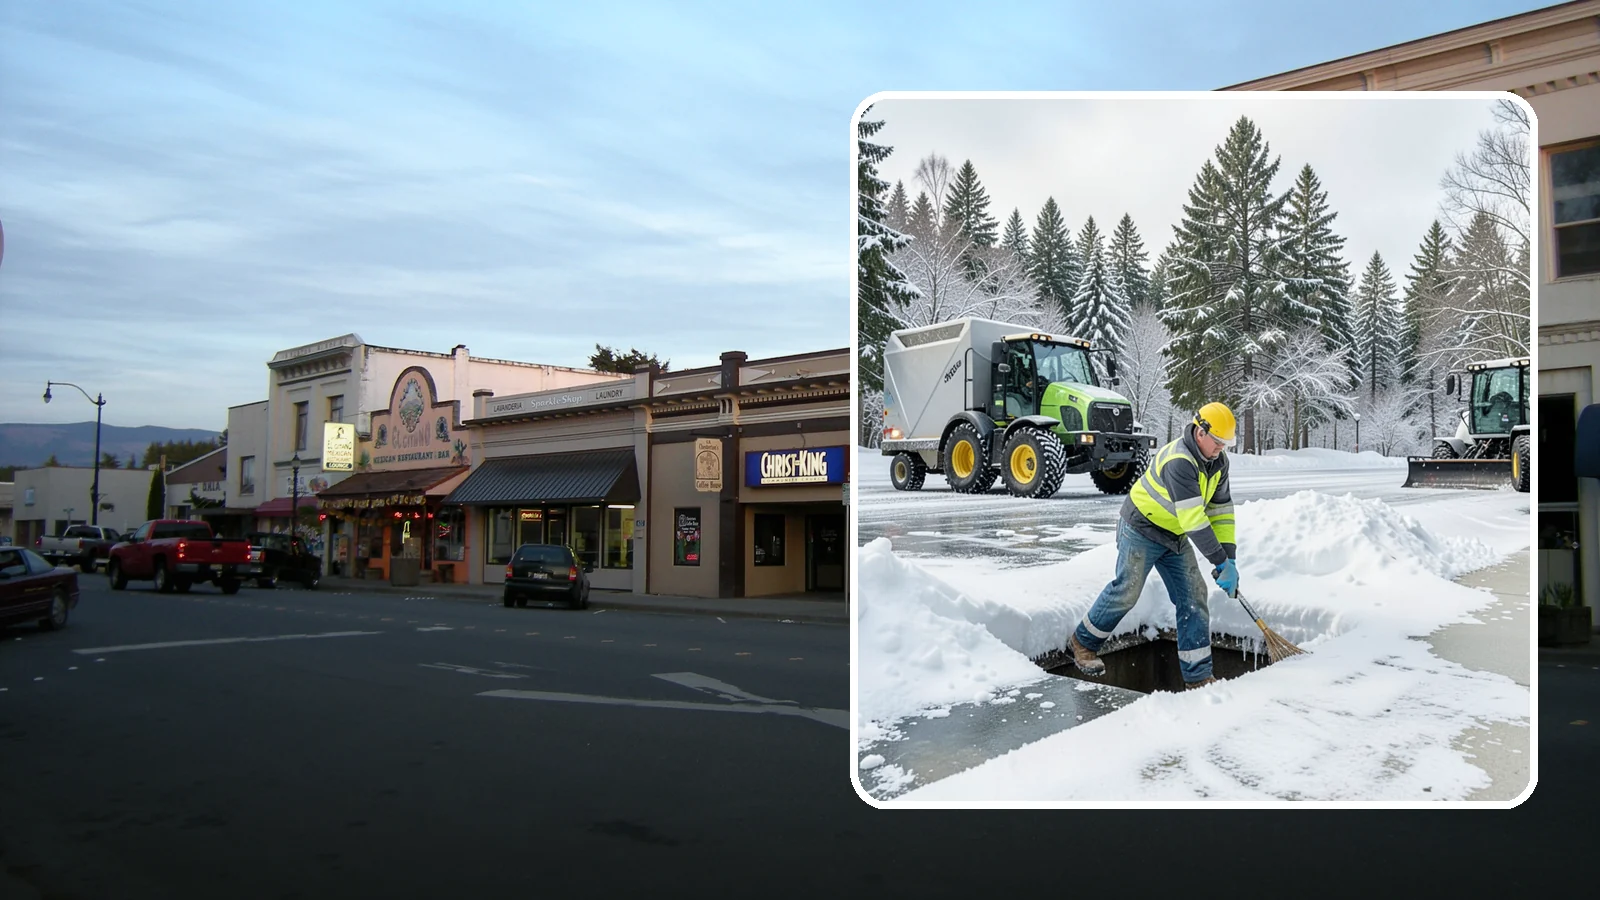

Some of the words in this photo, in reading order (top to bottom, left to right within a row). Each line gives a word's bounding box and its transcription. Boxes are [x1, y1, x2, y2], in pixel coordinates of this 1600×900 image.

[493, 402, 523, 413] LAVANDERIA
[531, 398, 561, 410] Sparkle
[562, 393, 583, 406] Shop
[595, 388, 624, 400] LAUNDRY
[374, 453, 396, 464] MEXICAN
[397, 451, 434, 462] RESTAURANT
[438, 450, 450, 459] BAR
[761, 452, 798, 478] CHRIST
[799, 450, 827, 476] KING
[696, 480, 709, 489] Coffee
